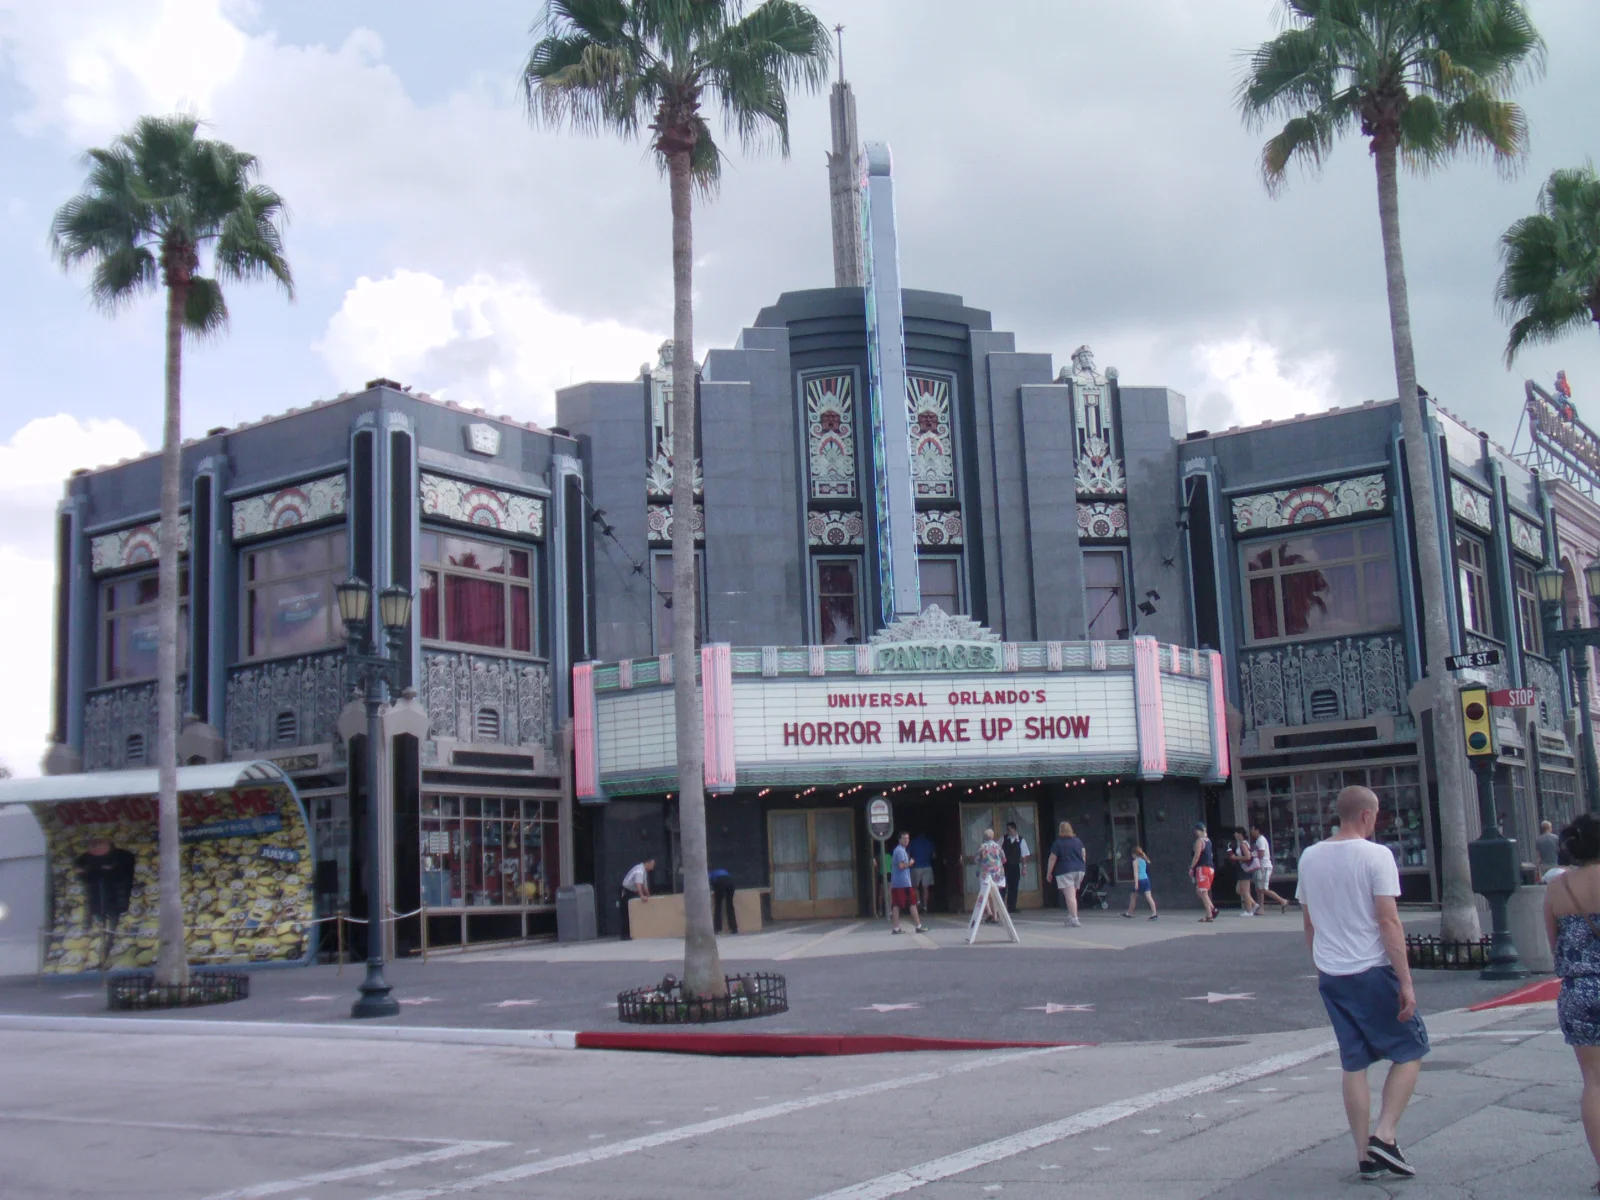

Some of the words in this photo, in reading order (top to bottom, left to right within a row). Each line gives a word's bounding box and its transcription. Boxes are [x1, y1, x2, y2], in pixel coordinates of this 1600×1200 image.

[879, 644, 997, 671] PANTAGES
[1453, 655, 1473, 668] VINE
[1476, 653, 1491, 665] ST.
[827, 692, 928, 708] UNIVERSAL
[948, 689, 1047, 706] ORLANDO'S
[1508, 689, 1534, 706] STOP
[783, 720, 882, 746] HORROR
[898, 718, 971, 744] MAKE
[981, 717, 1013, 741] UP
[1024, 715, 1091, 740] SHOW
[261, 848, 286, 860] JULY
[286, 852, 295, 861] 9
